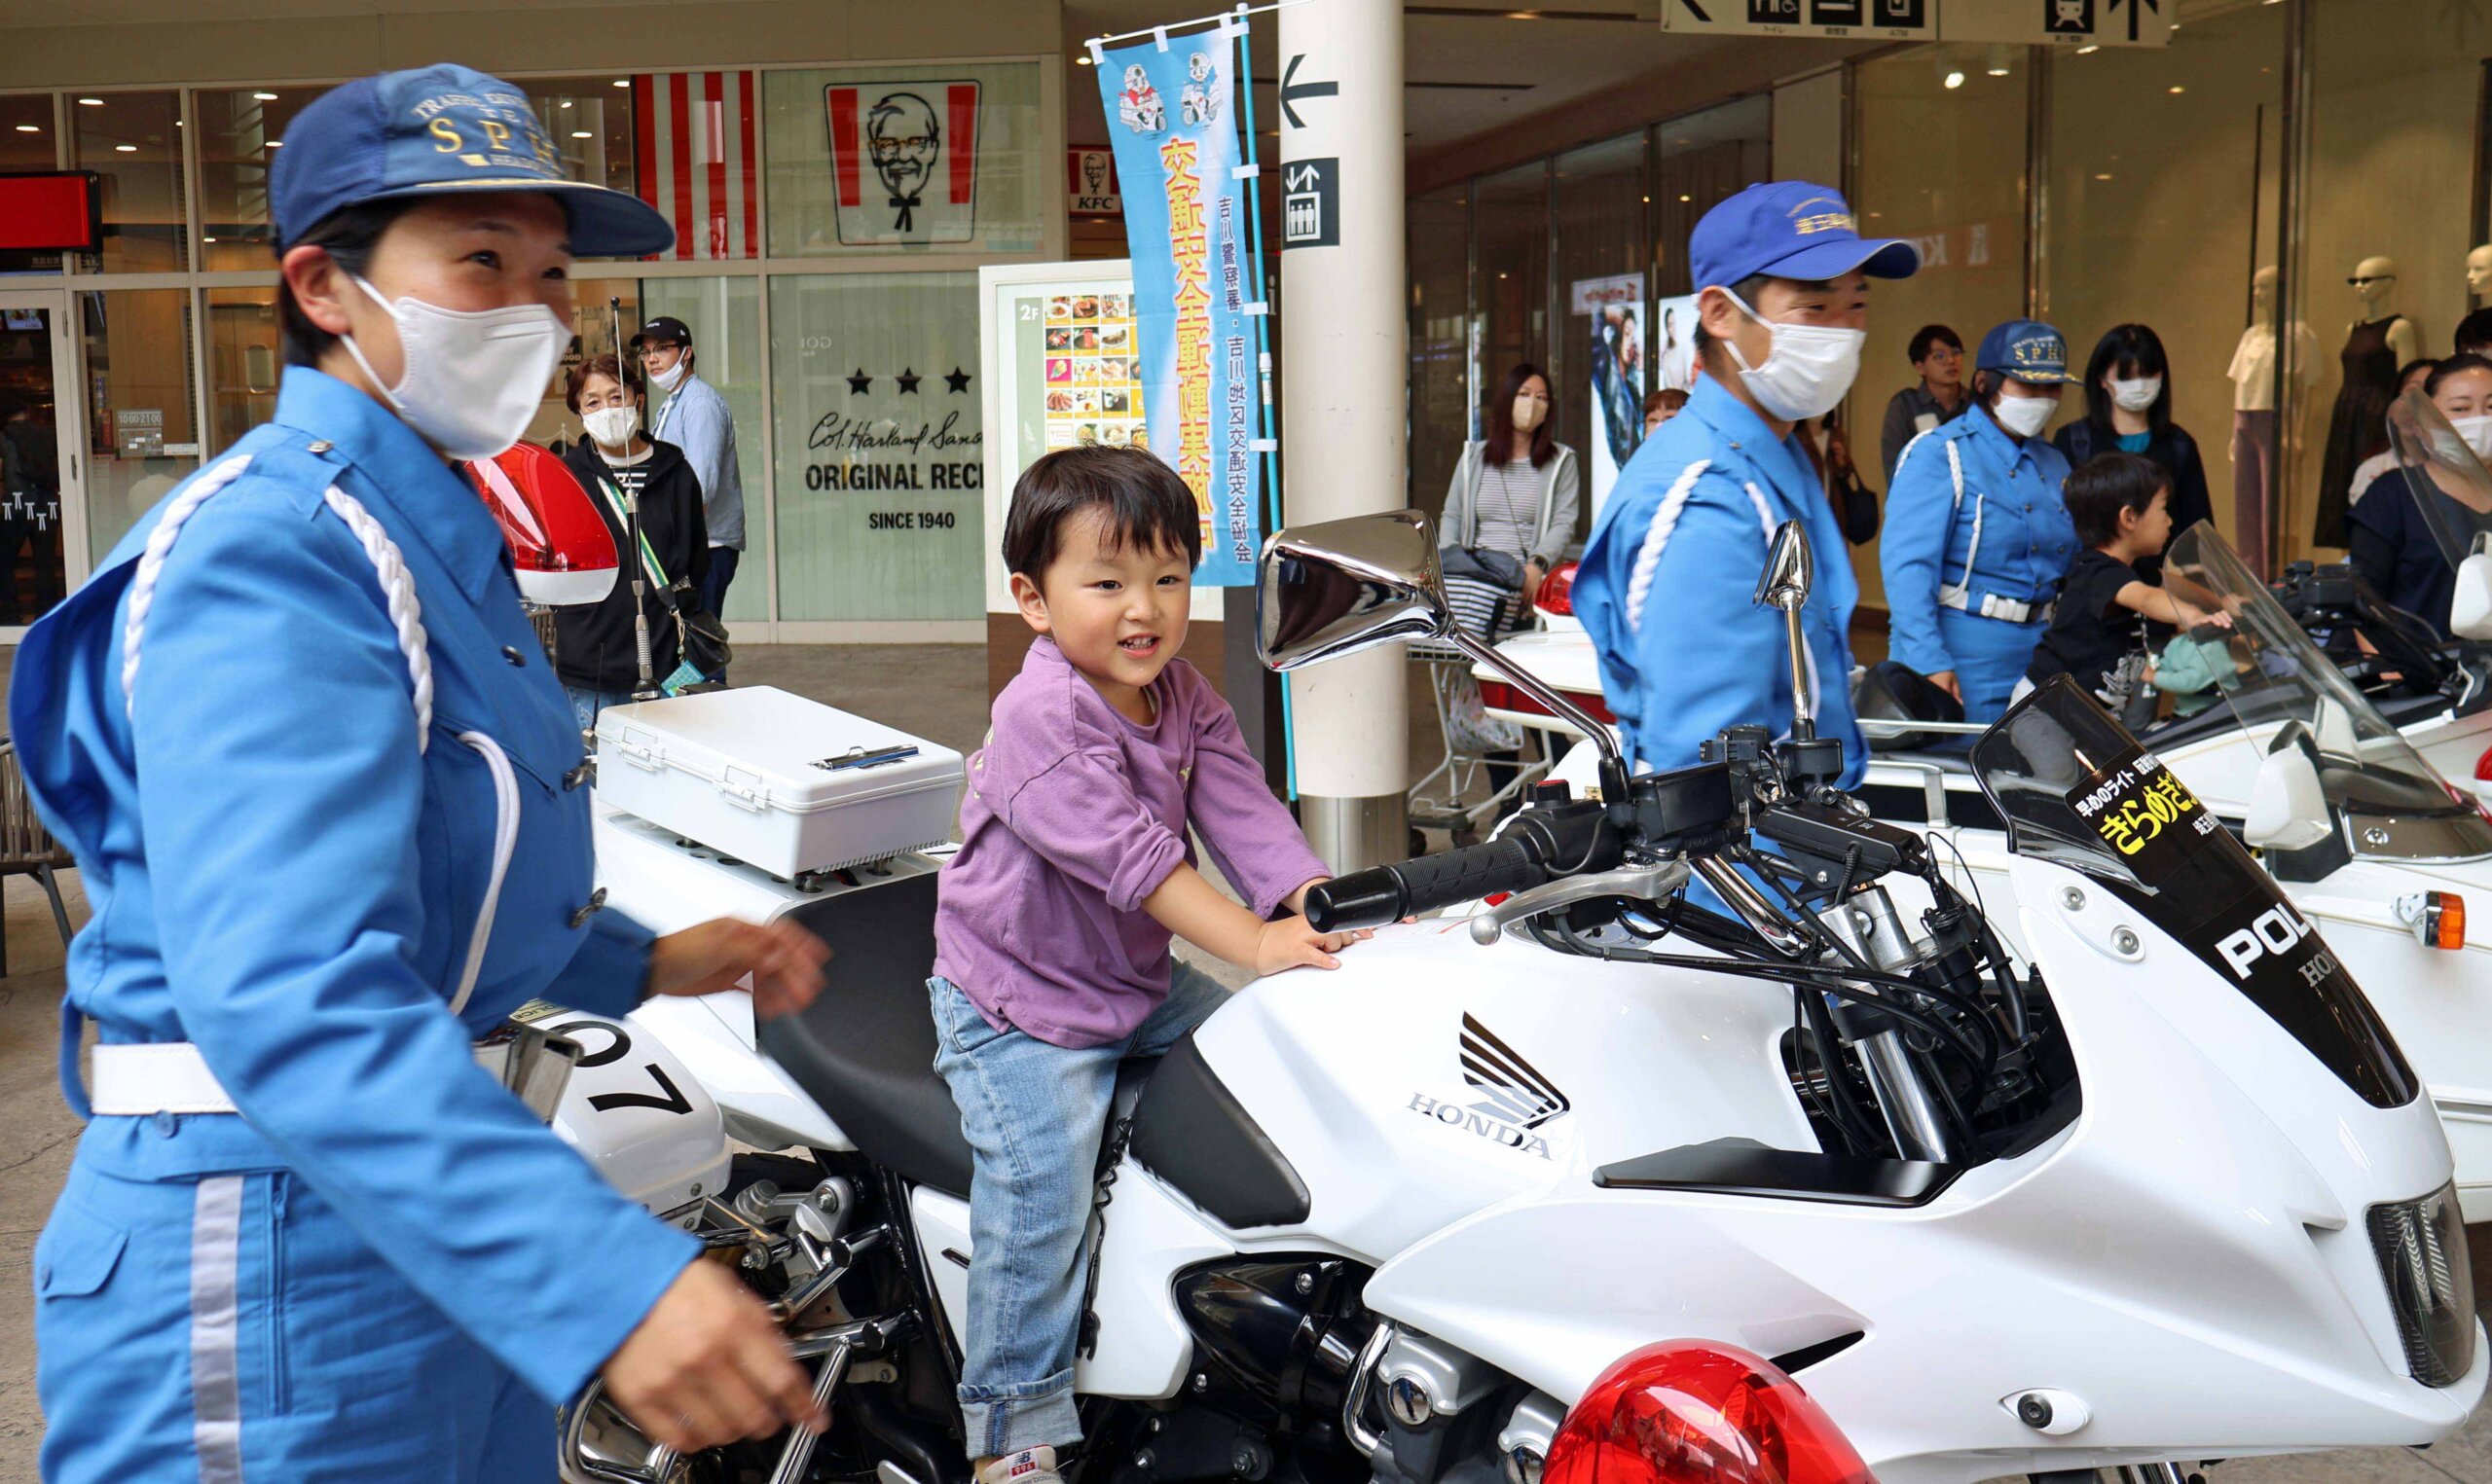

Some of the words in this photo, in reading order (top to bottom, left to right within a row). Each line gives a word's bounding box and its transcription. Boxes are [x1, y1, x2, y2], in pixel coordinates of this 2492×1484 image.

[1078, 197, 1114, 210] KFC
[1019, 304, 1040, 321] 2F
[808, 412, 851, 451] Col.
[847, 421, 929, 454] Harland
[806, 463, 924, 490] ORIGINAL
[931, 462, 983, 489] RECI
[869, 512, 913, 529] SINCE
[918, 512, 955, 528] 1940
[2074, 770, 2135, 817] 早めのライト
[1407, 1091, 1554, 1161] HONDA
